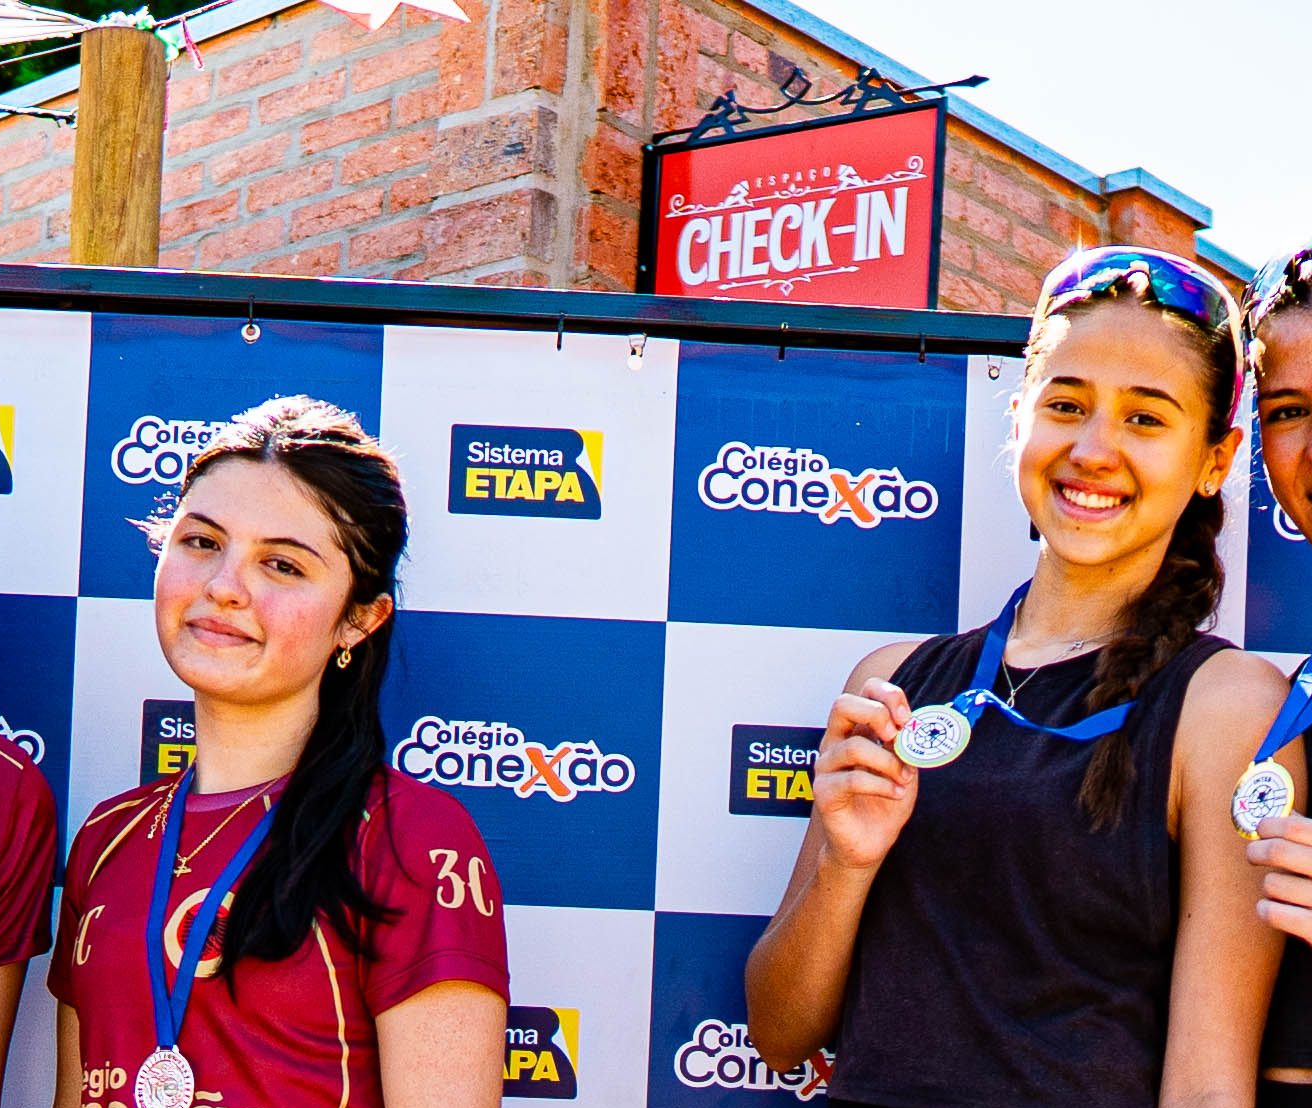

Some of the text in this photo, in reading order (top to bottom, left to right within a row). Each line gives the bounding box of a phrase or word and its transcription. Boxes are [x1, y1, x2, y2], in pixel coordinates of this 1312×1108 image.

[756, 166, 831, 189] ESPAÇO
[677, 187, 909, 287] CHECK-IN
[467, 441, 564, 467] Sistema
[723, 445, 825, 476] Colégio
[463, 466, 585, 504] ETAPA
[417, 720, 520, 750] Colégio
[746, 768, 815, 801] ETA
[428, 848, 494, 917] 3C
